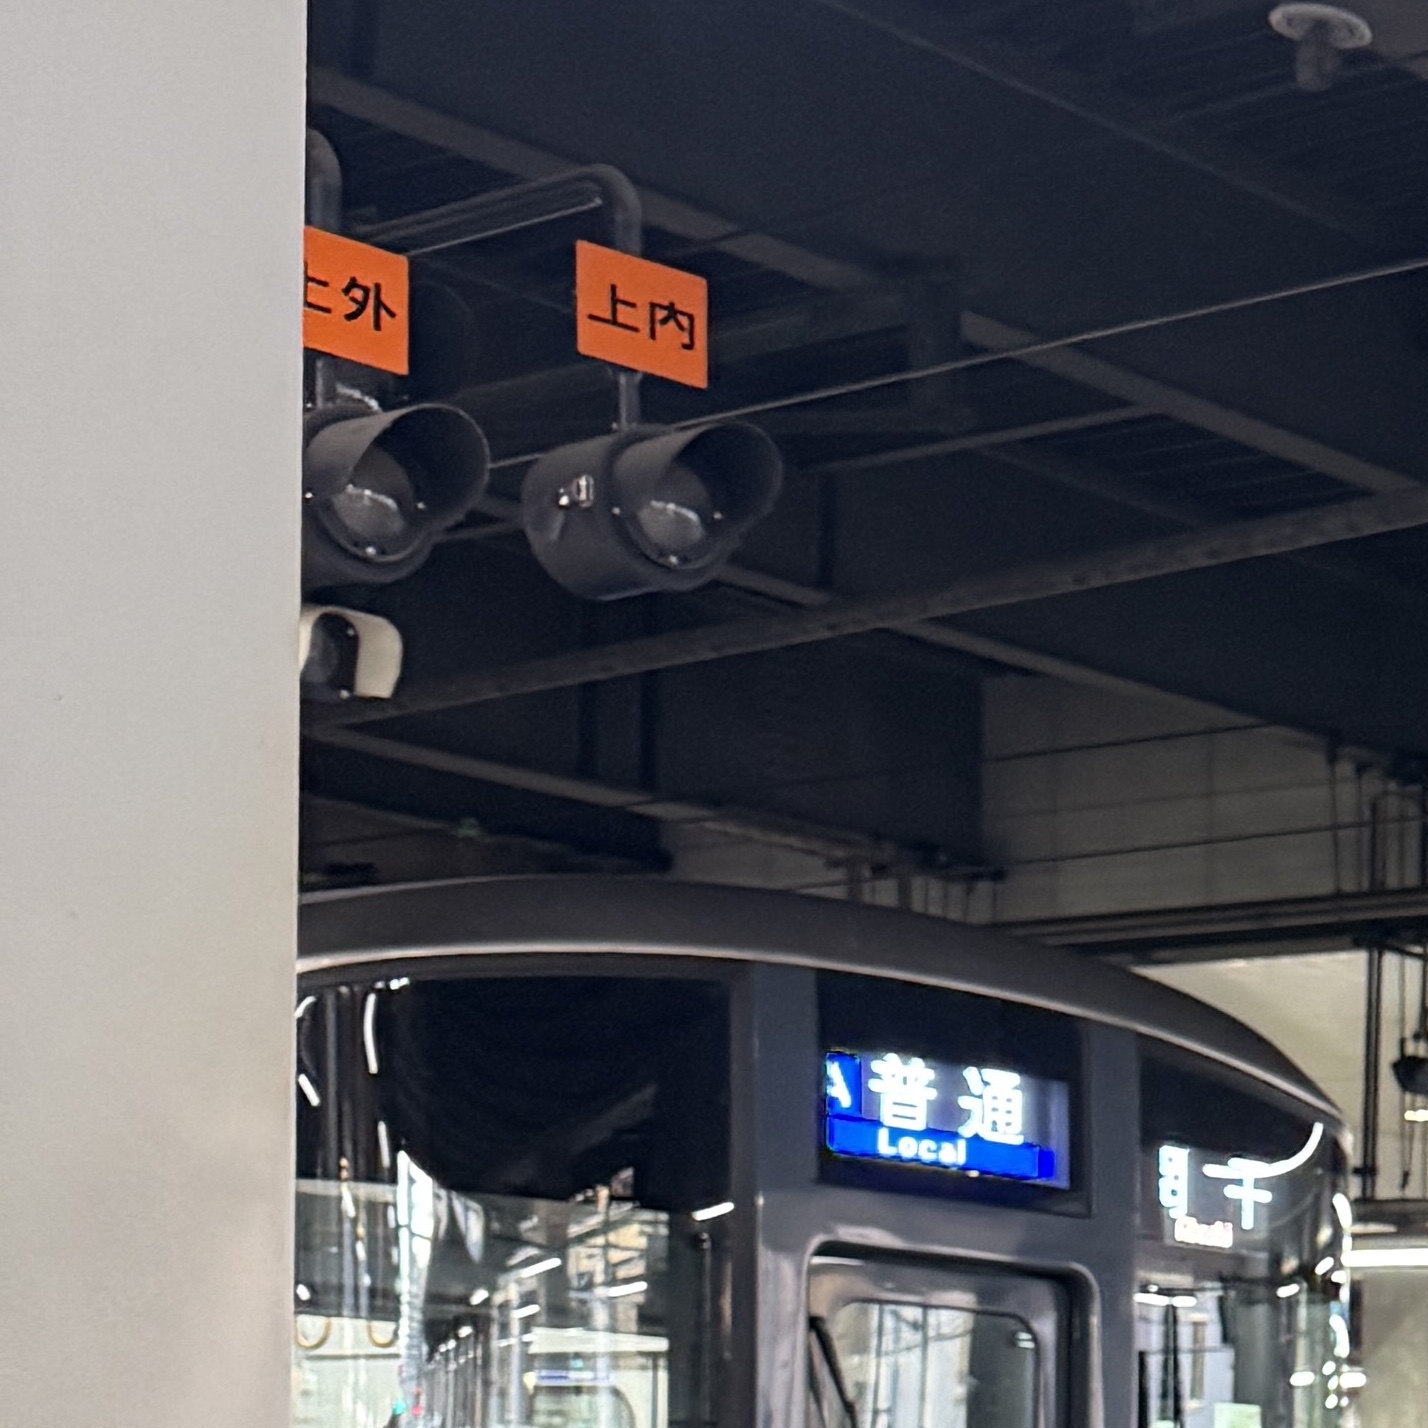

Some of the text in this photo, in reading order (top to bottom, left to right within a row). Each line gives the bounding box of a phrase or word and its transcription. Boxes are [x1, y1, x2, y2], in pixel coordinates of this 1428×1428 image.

[587, 284, 694, 350] 上内
[868, 1052, 1024, 1146] 普通
[877, 1127, 967, 1167] Local
